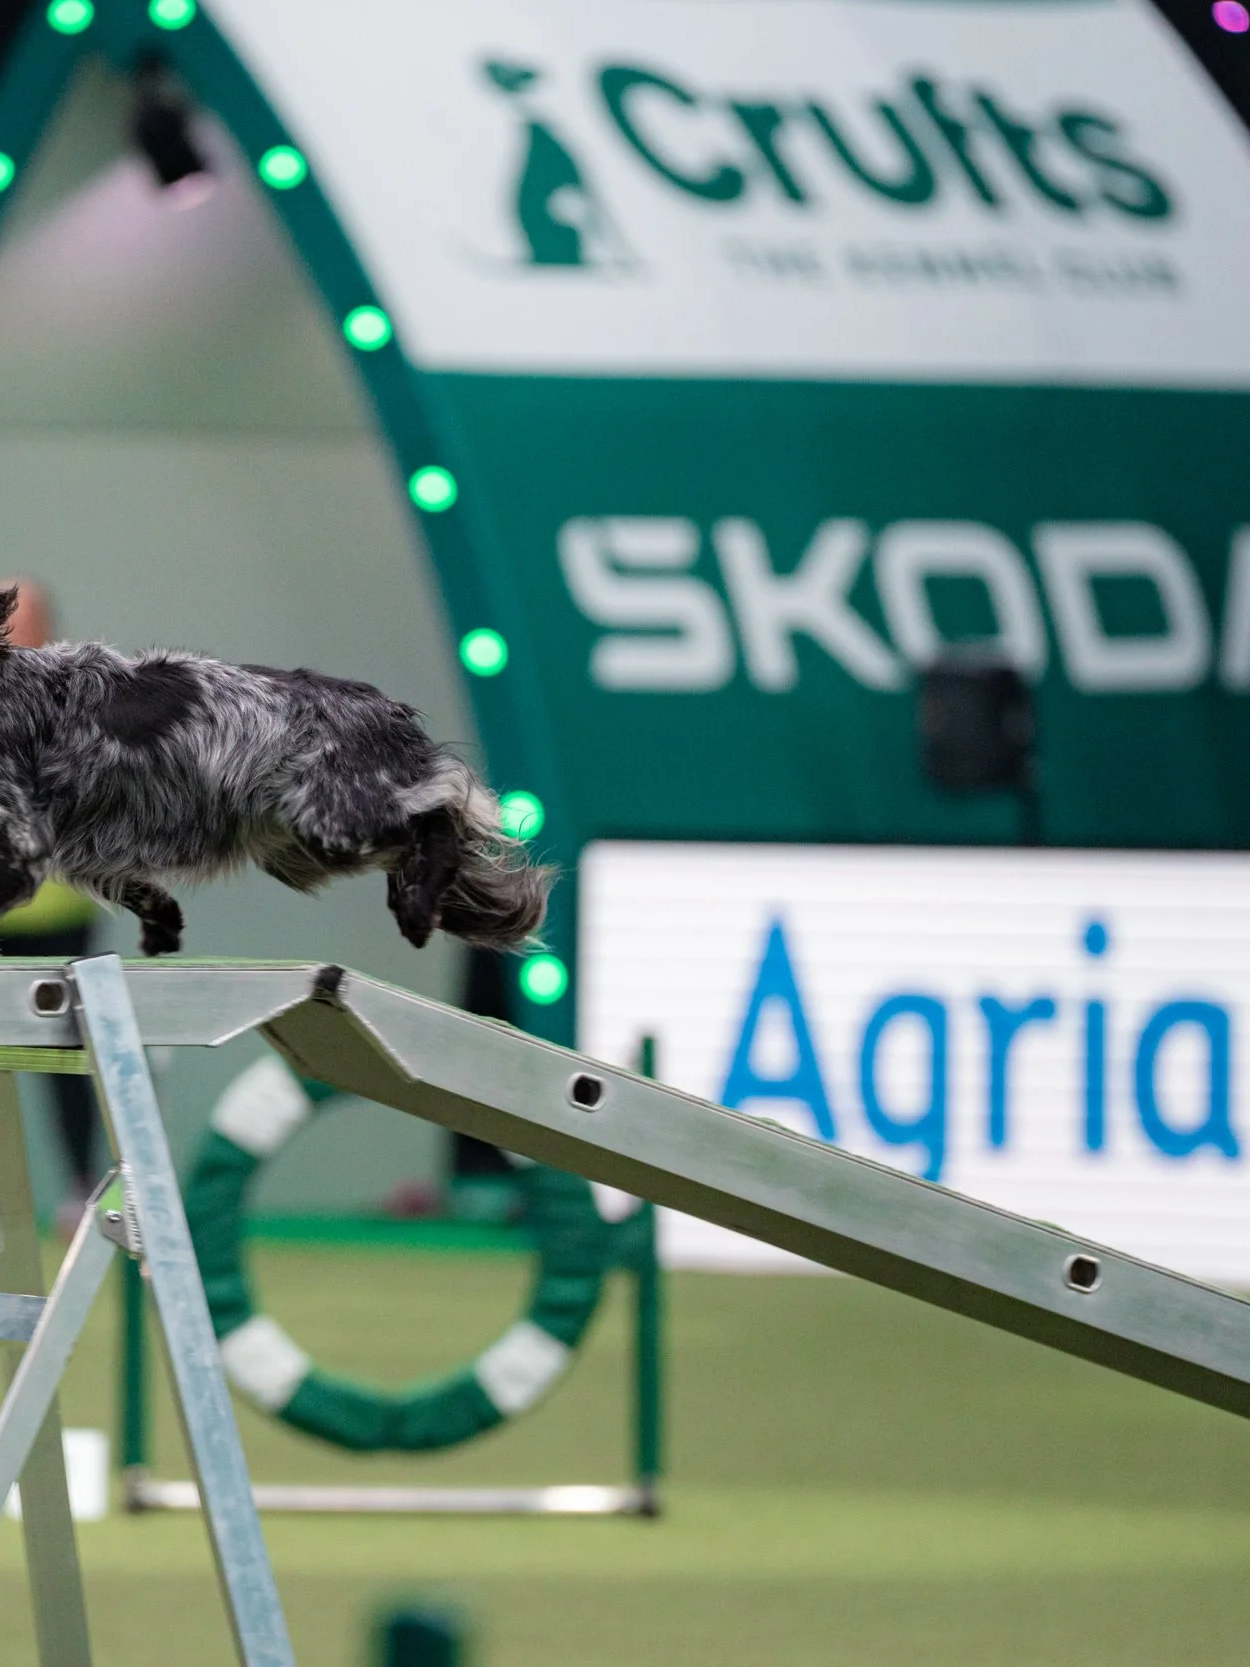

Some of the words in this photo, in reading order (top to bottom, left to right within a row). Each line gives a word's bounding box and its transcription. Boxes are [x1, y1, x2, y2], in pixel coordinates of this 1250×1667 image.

[595, 62, 1175, 222] Crufts
[556, 515, 1250, 693] SKOD
[718, 911, 1240, 1183] Agria
